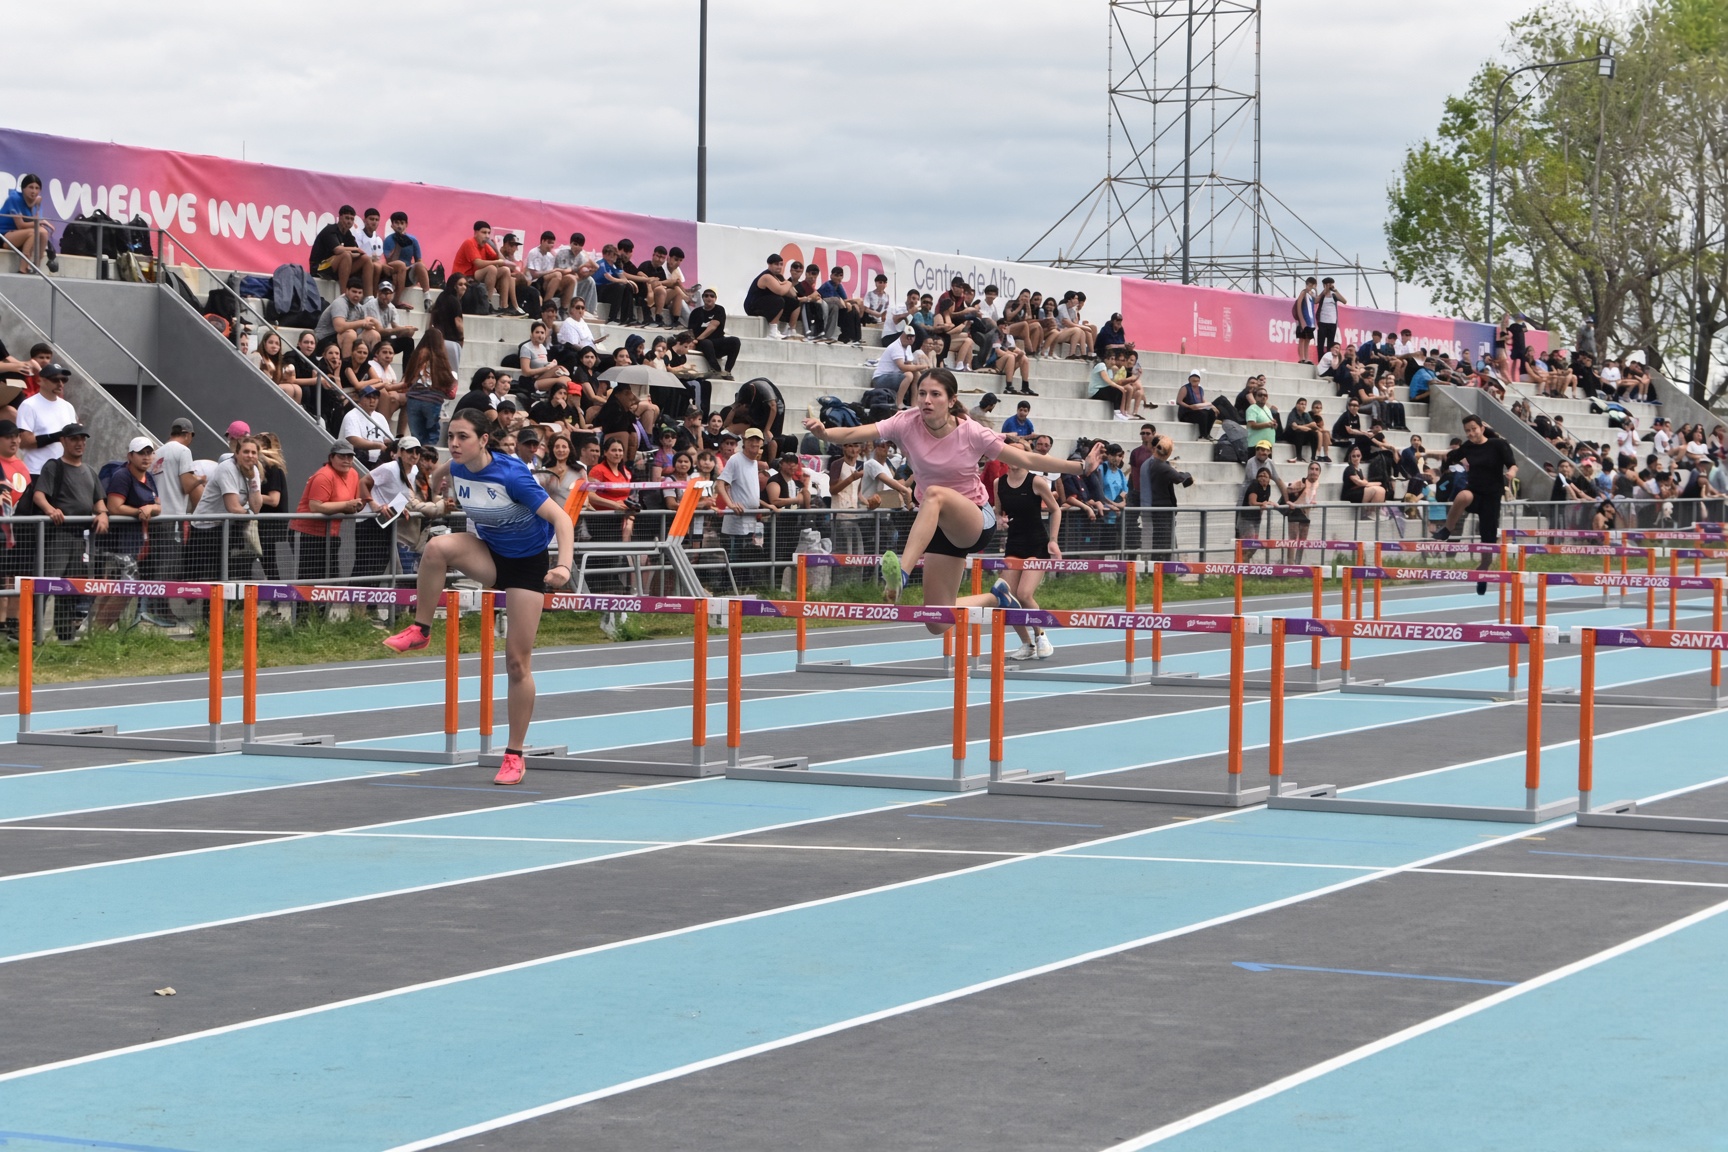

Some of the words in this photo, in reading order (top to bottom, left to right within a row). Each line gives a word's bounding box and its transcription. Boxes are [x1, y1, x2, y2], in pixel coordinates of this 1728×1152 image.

[49, 178, 197, 234] VUELVE
[968, 265, 985, 295] de
[990, 267, 1016, 298] Alto
[459, 485, 470, 498] M
[845, 556, 874, 565] SANTA
[1023, 561, 1052, 569] SANTA
[1053, 561, 1065, 570] FE
[1066, 561, 1088, 570] 2026
[1205, 564, 1236, 573] SANTA
[1237, 565, 1248, 574] FE
[1250, 566, 1273, 575] 2026
[1396, 569, 1428, 578] SANTA
[1430, 570, 1442, 579] FE
[1443, 570, 1468, 580] 2026
[1593, 576, 1628, 585] SANTA
[1630, 577, 1642, 586] FE
[1644, 577, 1669, 586] 2026
[84, 582, 121, 594] SANTA
[123, 582, 136, 594] FE
[138, 583, 166, 595] 2026
[310, 589, 350, 601] SANTA
[352, 590, 366, 602] FE
[367, 590, 396, 603] 2026
[551, 597, 592, 610] SANTA
[594, 598, 609, 610] FE
[611, 599, 641, 612] 2026
[803, 604, 846, 617] SANTA
[848, 605, 864, 618] FE
[865, 606, 899, 619] 2026
[1069, 613, 1115, 627] SANTA
[1117, 614, 1133, 628] FE
[1136, 616, 1171, 629] 2026
[1352, 623, 1402, 638] SANTA
[1404, 624, 1422, 639] FE
[1424, 625, 1462, 640] 2026
[1670, 633, 1724, 648] SANTA
